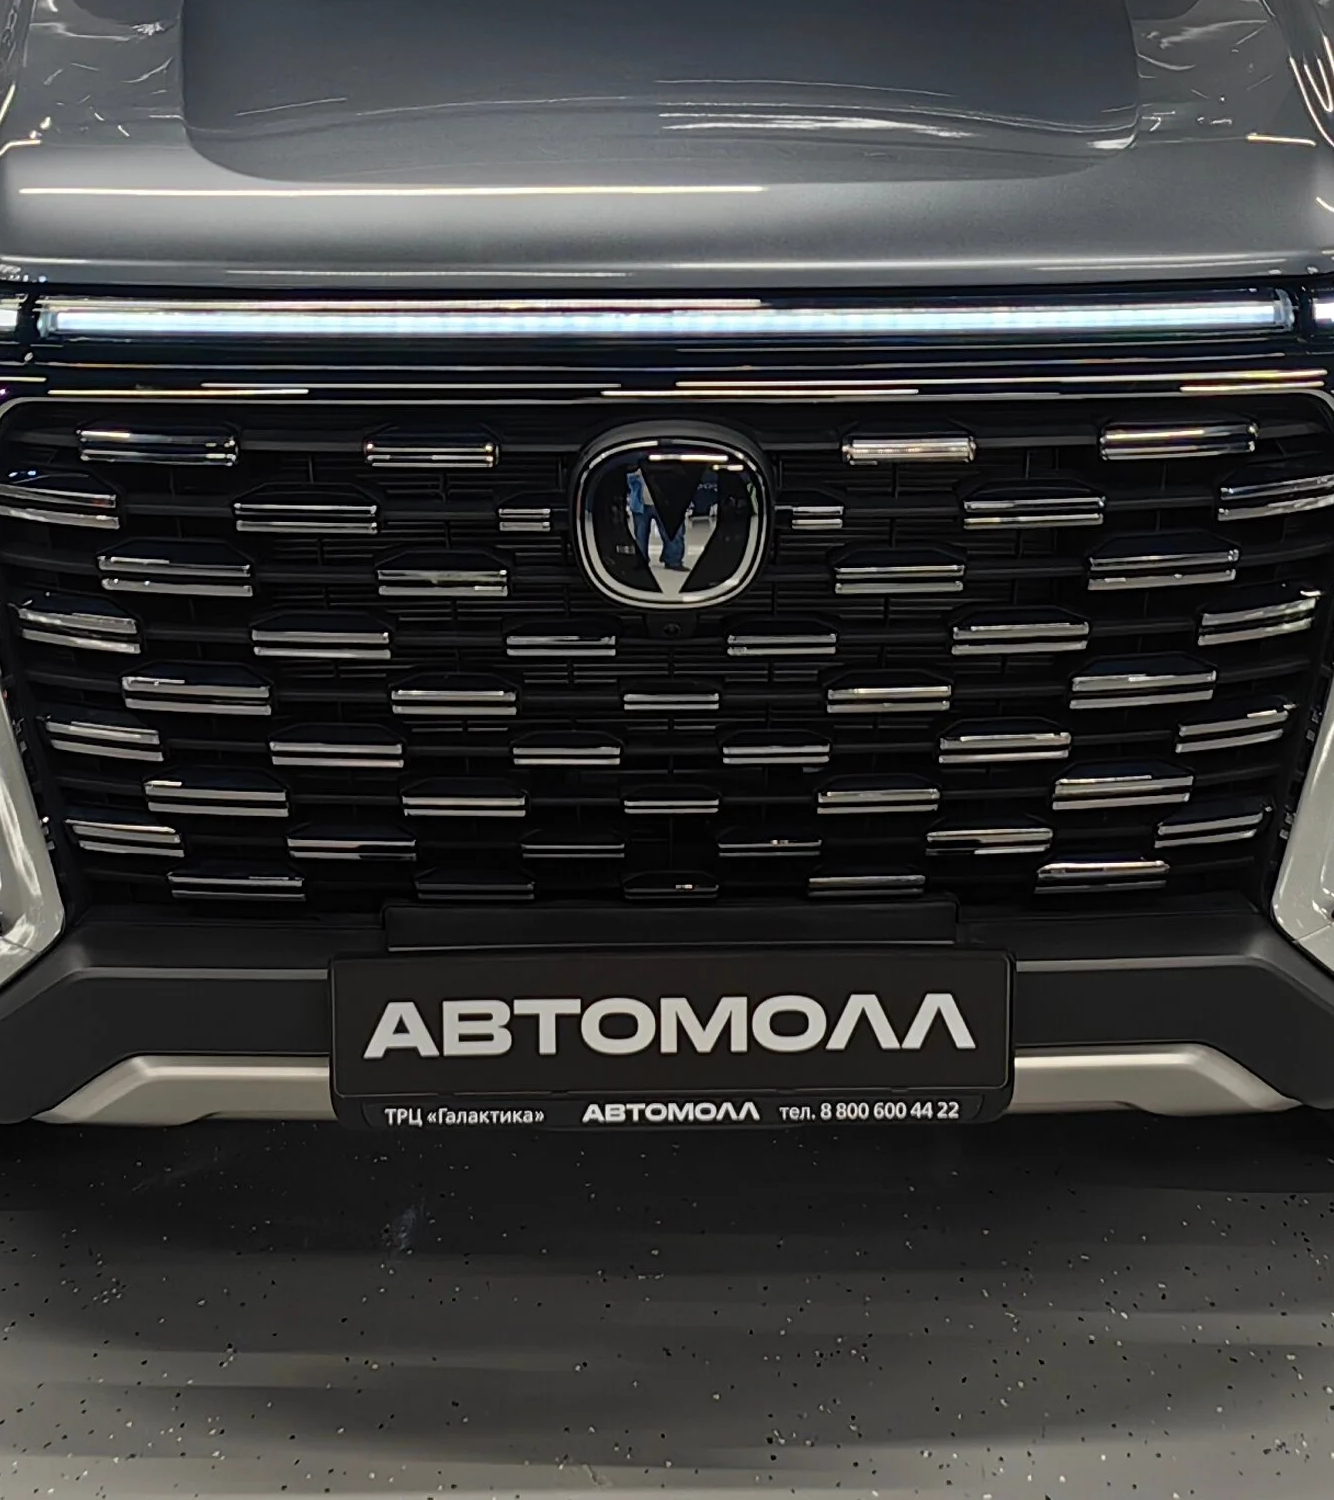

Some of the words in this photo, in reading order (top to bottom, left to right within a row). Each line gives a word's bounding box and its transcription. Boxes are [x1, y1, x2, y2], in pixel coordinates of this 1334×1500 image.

[363, 993, 976, 1059] АВТОМОЛЛ
[384, 1107, 423, 1127] ТРЦ
[426, 1107, 544, 1126] «Галактика»
[582, 1101, 760, 1123] АВТОМОЛЛ
[779, 1105, 816, 1121] тел.
[820, 1102, 832, 1121] 8
[835, 1102, 869, 1121] 800
[873, 1101, 907, 1120] 600
[910, 1101, 933, 1119] 44
[936, 1101, 959, 1119] 22
